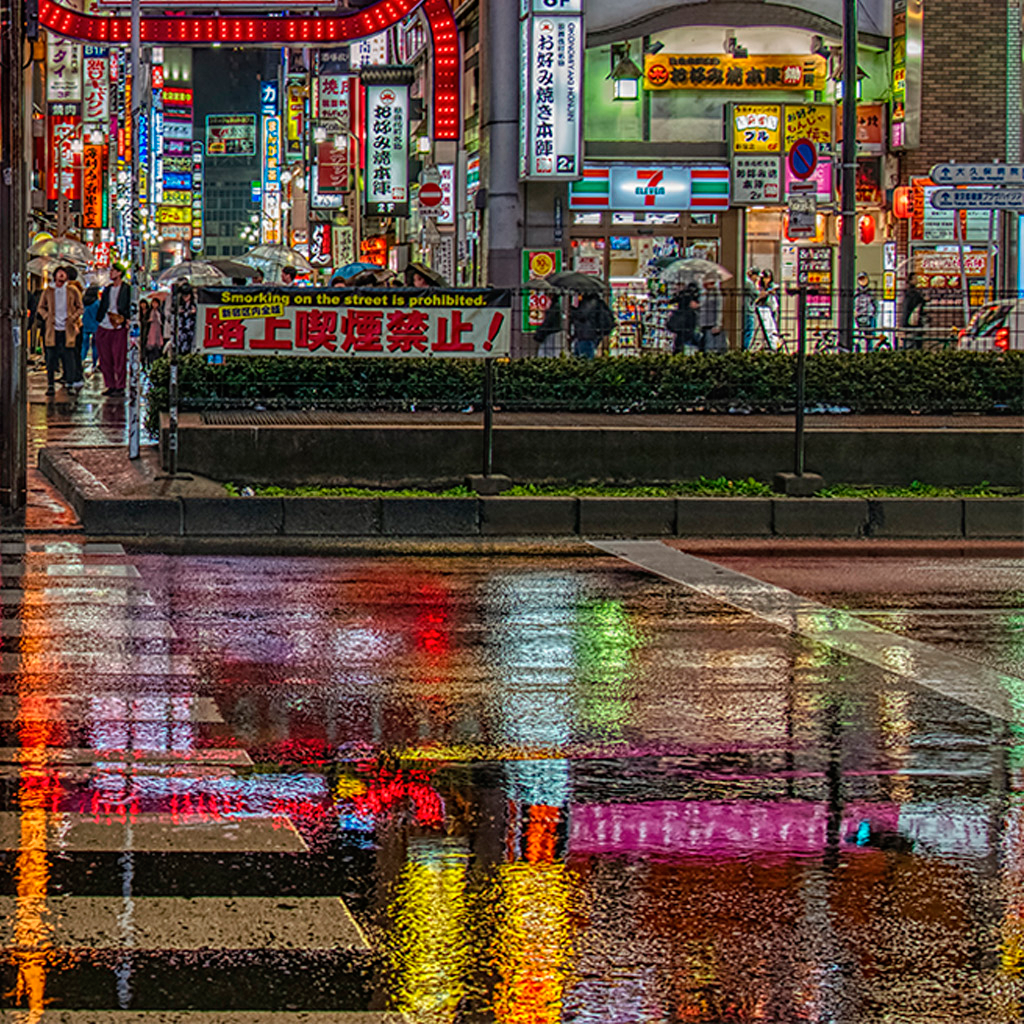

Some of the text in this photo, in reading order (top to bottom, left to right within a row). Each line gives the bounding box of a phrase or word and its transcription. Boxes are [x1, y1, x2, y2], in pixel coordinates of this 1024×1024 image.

[536, 35, 555, 157] お好み焼き本陣
[558, 157, 574, 171] 2F
[636, 187, 665, 195] ELEVEN
[377, 203, 395, 213] 2F
[221, 291, 487, 308] Smorking on the street is prohibited.
